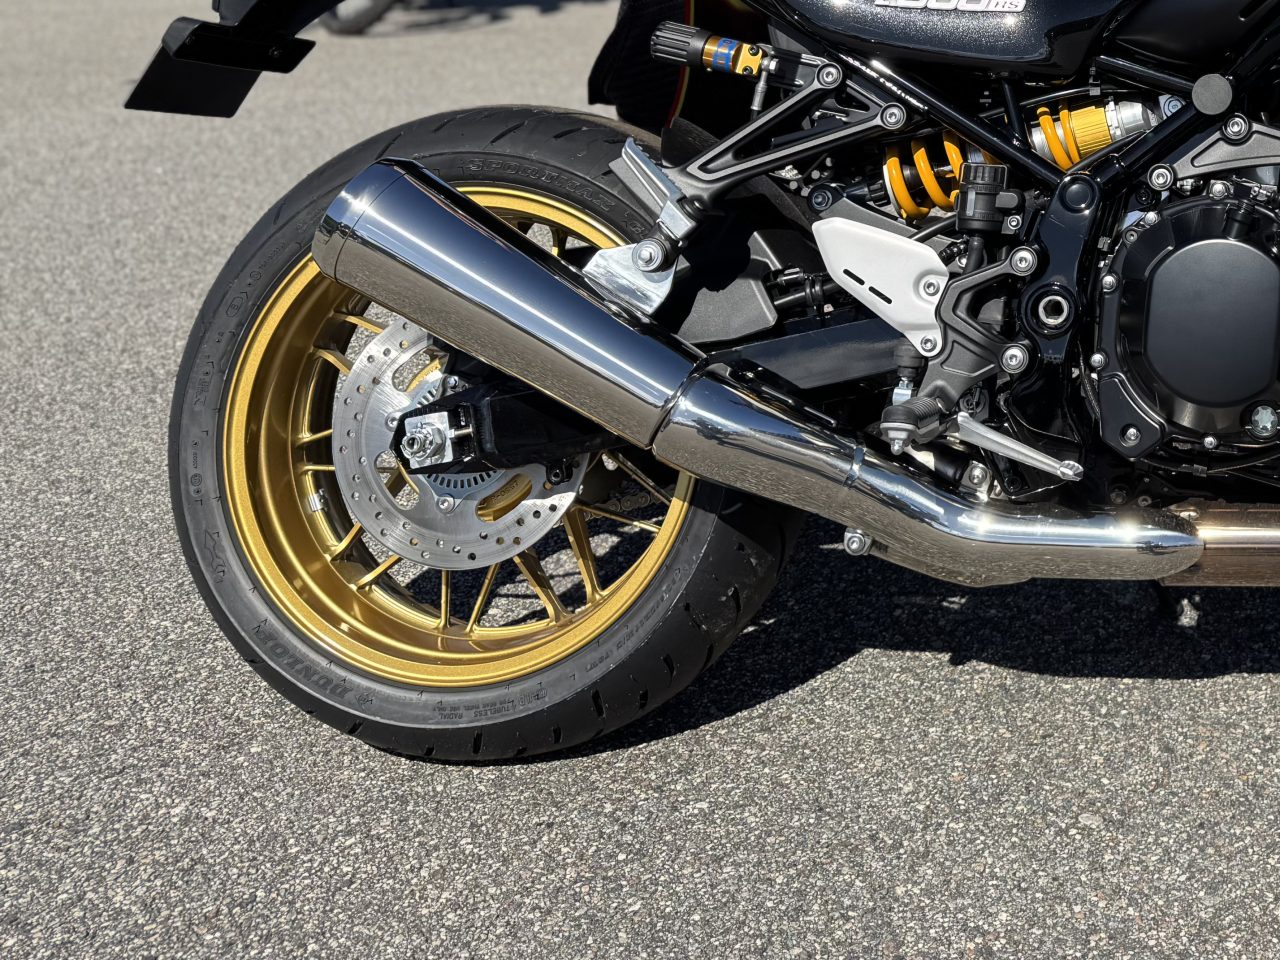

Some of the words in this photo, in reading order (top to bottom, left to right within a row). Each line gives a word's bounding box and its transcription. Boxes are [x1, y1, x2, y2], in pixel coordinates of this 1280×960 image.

[253, 629, 353, 699] DUNLOP
[439, 712, 463, 720] RADIAL
[473, 704, 511, 718] TUBELESS
